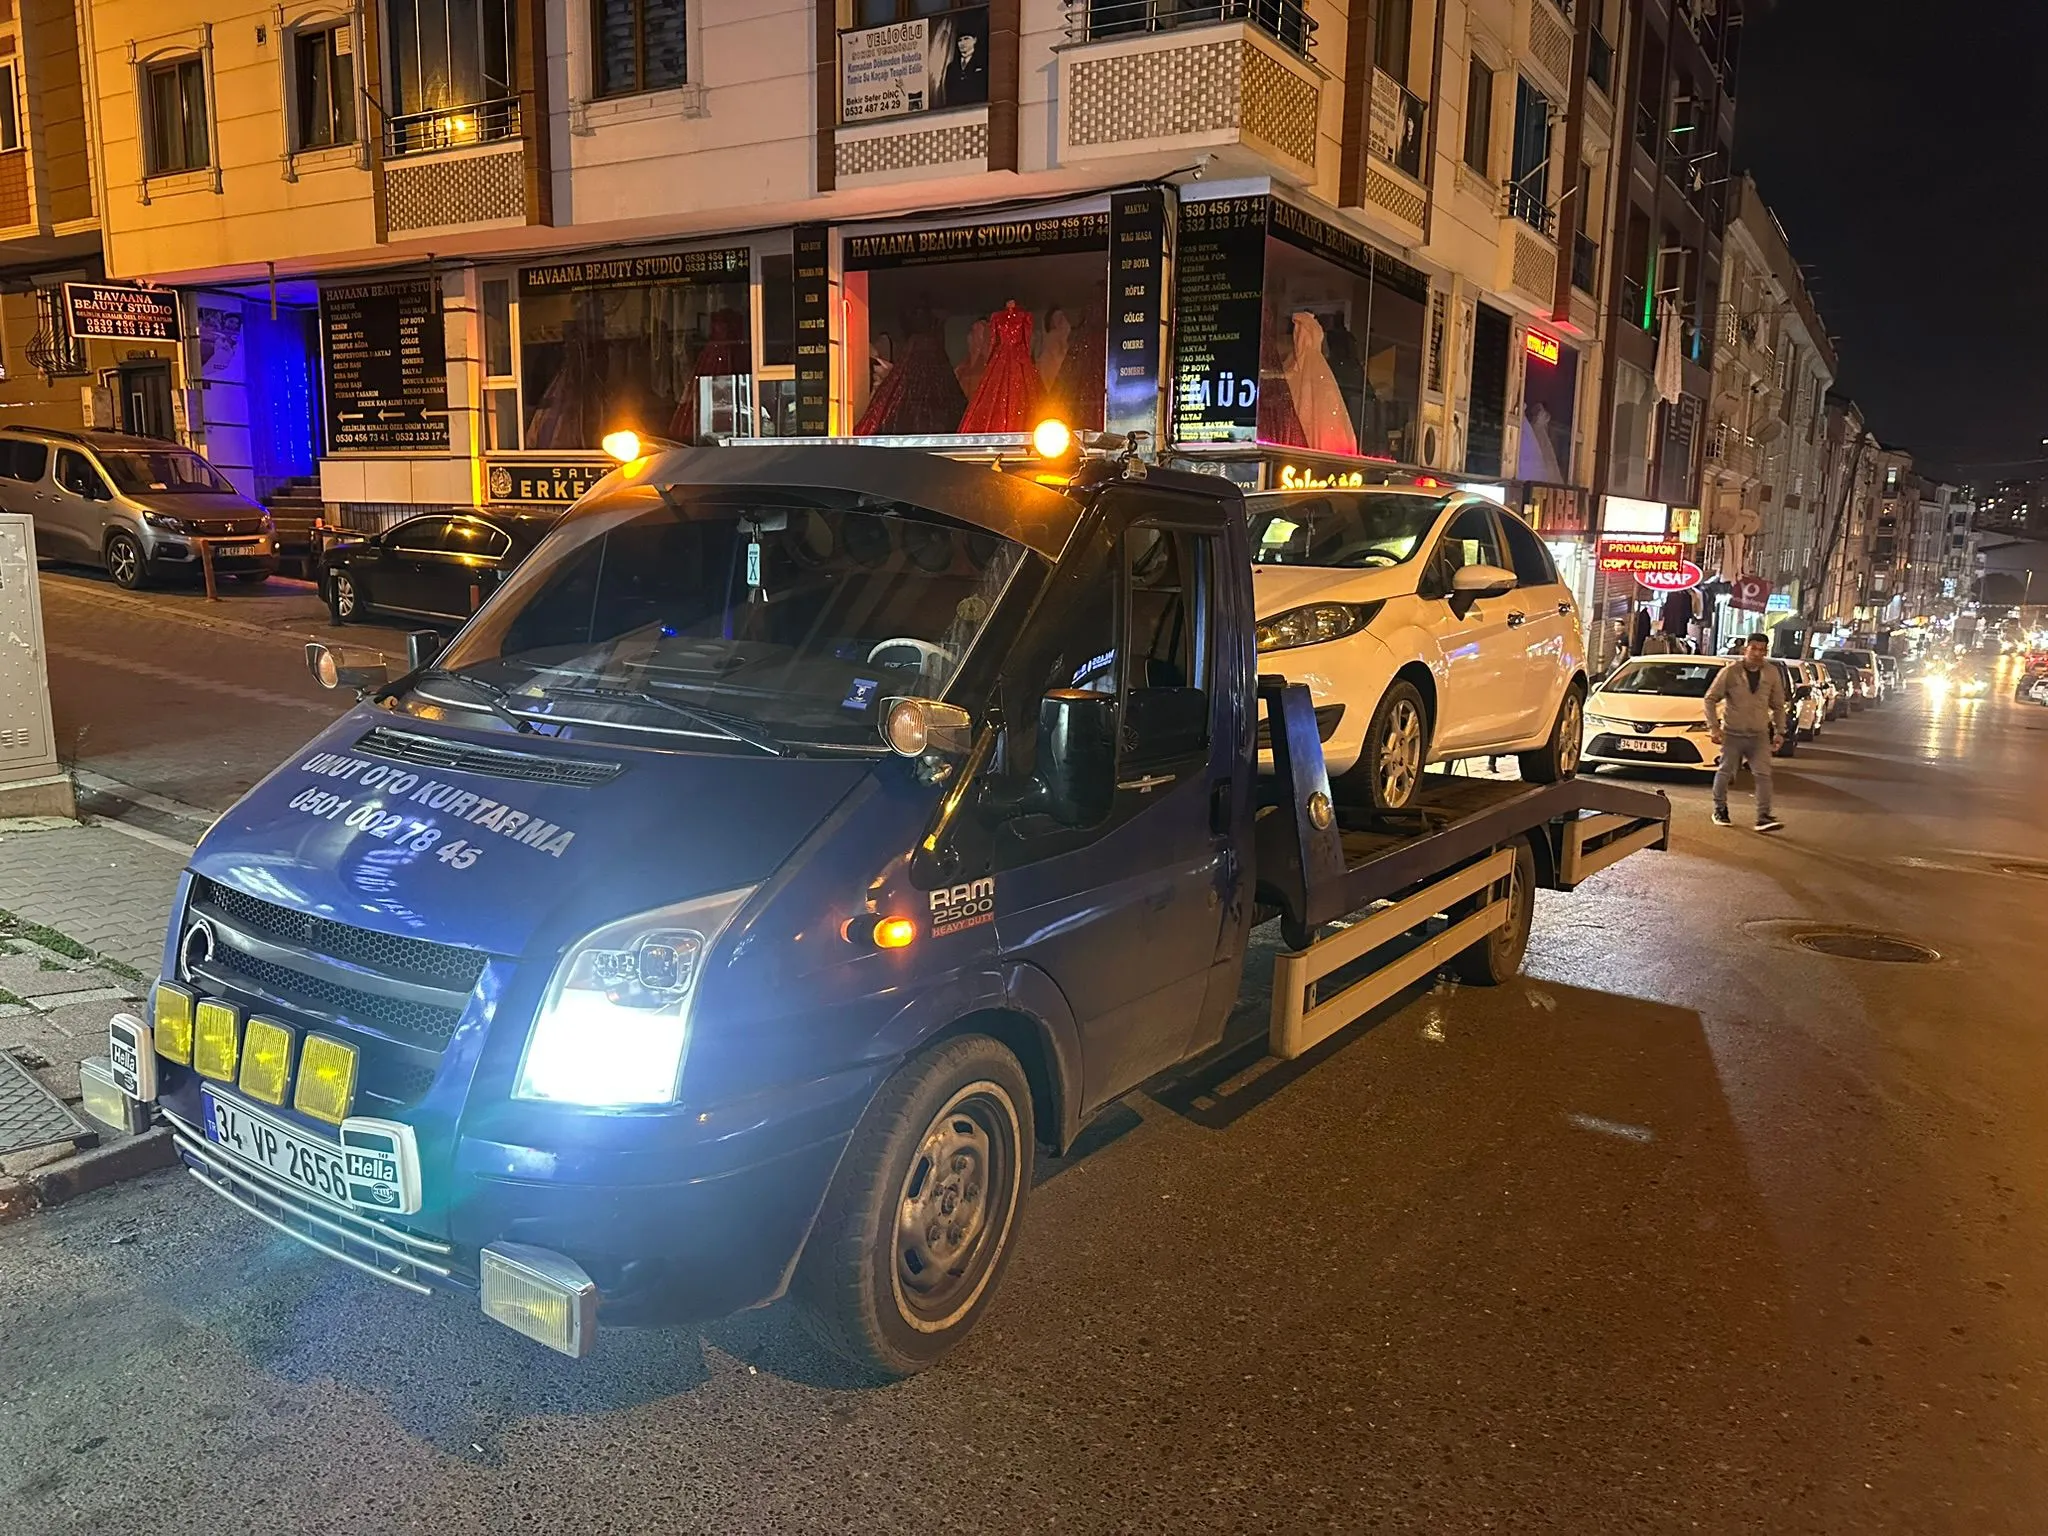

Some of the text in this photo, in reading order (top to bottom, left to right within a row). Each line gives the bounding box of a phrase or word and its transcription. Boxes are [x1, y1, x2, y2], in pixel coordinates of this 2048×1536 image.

[866, 24, 922, 48] VELİOĞLU
[847, 97, 863, 105] Bekir
[865, 93, 881, 102] Sefer
[846, 100, 900, 116] 0532 487 24 29
[1124, 203, 1150, 214] MAKYAJ
[1179, 198, 1265, 217] 530 456 73 41
[1035, 215, 1108, 230] 0530 456 73 41
[1179, 213, 1265, 233] 532 133 17 44
[1035, 230, 1058, 241] 0532
[1062, 228, 1079, 239] 133
[1083, 227, 1094, 236] 17
[1274, 202, 1323, 244] HAVAANA
[1325, 227, 1361, 260] BEAUTY
[852, 235, 915, 257] HAVAANA
[919, 228, 973, 252] BEAUTY
[977, 224, 1032, 247] STUDIO
[685, 254, 705, 263] 0530
[708, 252, 723, 260] 456
[1122, 258, 1149, 269] DİP BOYA
[529, 266, 582, 285] HAVAANA
[586, 260, 632, 280] BEAUTY
[636, 256, 683, 277] STUDIO
[685, 263, 705, 272] 0532
[708, 261, 723, 270] 133
[727, 260, 736, 269] 17
[93, 291, 152, 304] HAVAANA
[326, 283, 410, 300] HAVAANA BEAUTY
[1125, 285, 1145, 296] RÖFLE
[74, 299, 172, 315] BEAUTY STUDIO
[87, 318, 112, 326] 0530
[116, 320, 134, 328] 456
[1124, 312, 1144, 323] GÖLGE
[400, 327, 418, 335] RÖFLE
[1123, 340, 1144, 350] OMBRE
[1195, 354, 1215, 362] MAŞA
[1120, 367, 1145, 376] SOMBRE
[336, 434, 353, 443] 0530
[355, 433, 367, 442] 456
[369, 433, 378, 441] 73
[380, 433, 388, 441] 41
[395, 433, 413, 441] 0532
[416, 432, 429, 440] 133
[432, 432, 440, 440] 17
[521, 480, 594, 498] ERKE
[1609, 544, 1676, 555] PROMASYON
[1603, 559, 1678, 570] COPY CENTER
[1645, 572, 1692, 584] KASAP
[1651, 742, 1665, 750] 845
[301, 753, 576, 858] UMUT OTO KURTARMA
[289, 787, 483, 869] 0501 002 78 45
[930, 878, 994, 910] RAM
[933, 899, 993, 924] 2500
[932, 912, 993, 937] HEAVY DUTY
[114, 1046, 134, 1070] Hella
[208, 1105, 346, 1200] TR 34 VP 2656
[351, 1156, 393, 1181] Hella
